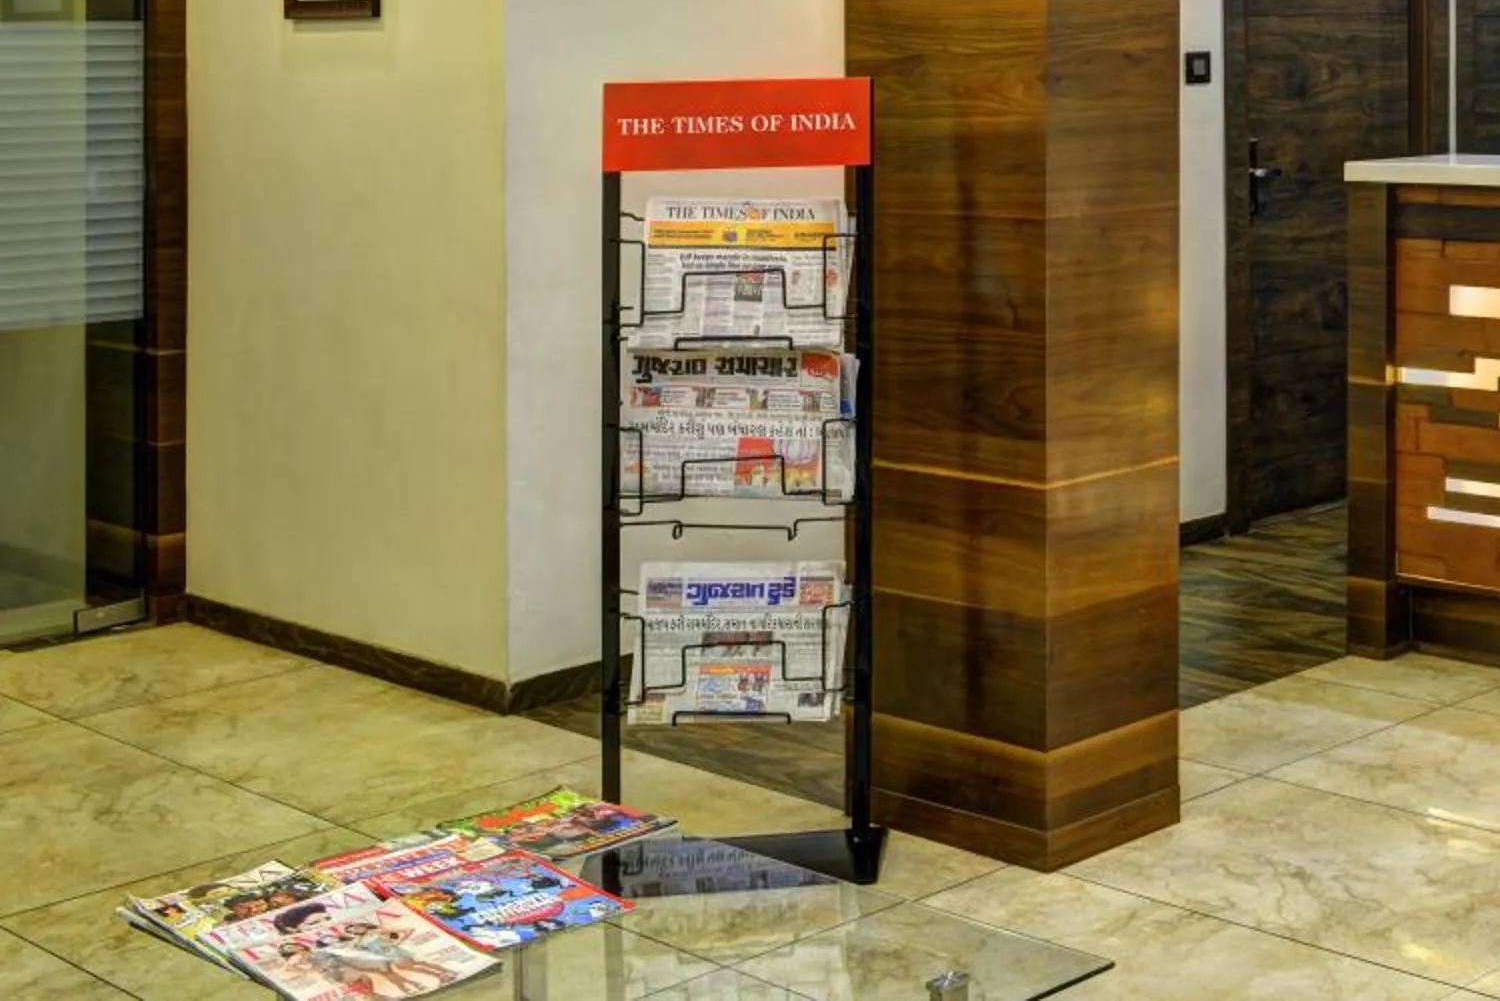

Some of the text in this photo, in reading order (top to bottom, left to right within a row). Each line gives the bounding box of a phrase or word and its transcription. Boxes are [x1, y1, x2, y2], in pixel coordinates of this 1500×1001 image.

[617, 112, 856, 136] THE TIMES OF INDIA
[666, 206, 698, 219] THE
[701, 206, 747, 220] TIMES
[772, 205, 816, 220] INDIA
[631, 355, 798, 384] ગુજરાત સમાચાર
[686, 582, 764, 605] ગુજરાત
[767, 576, 796, 605] ટુડે
